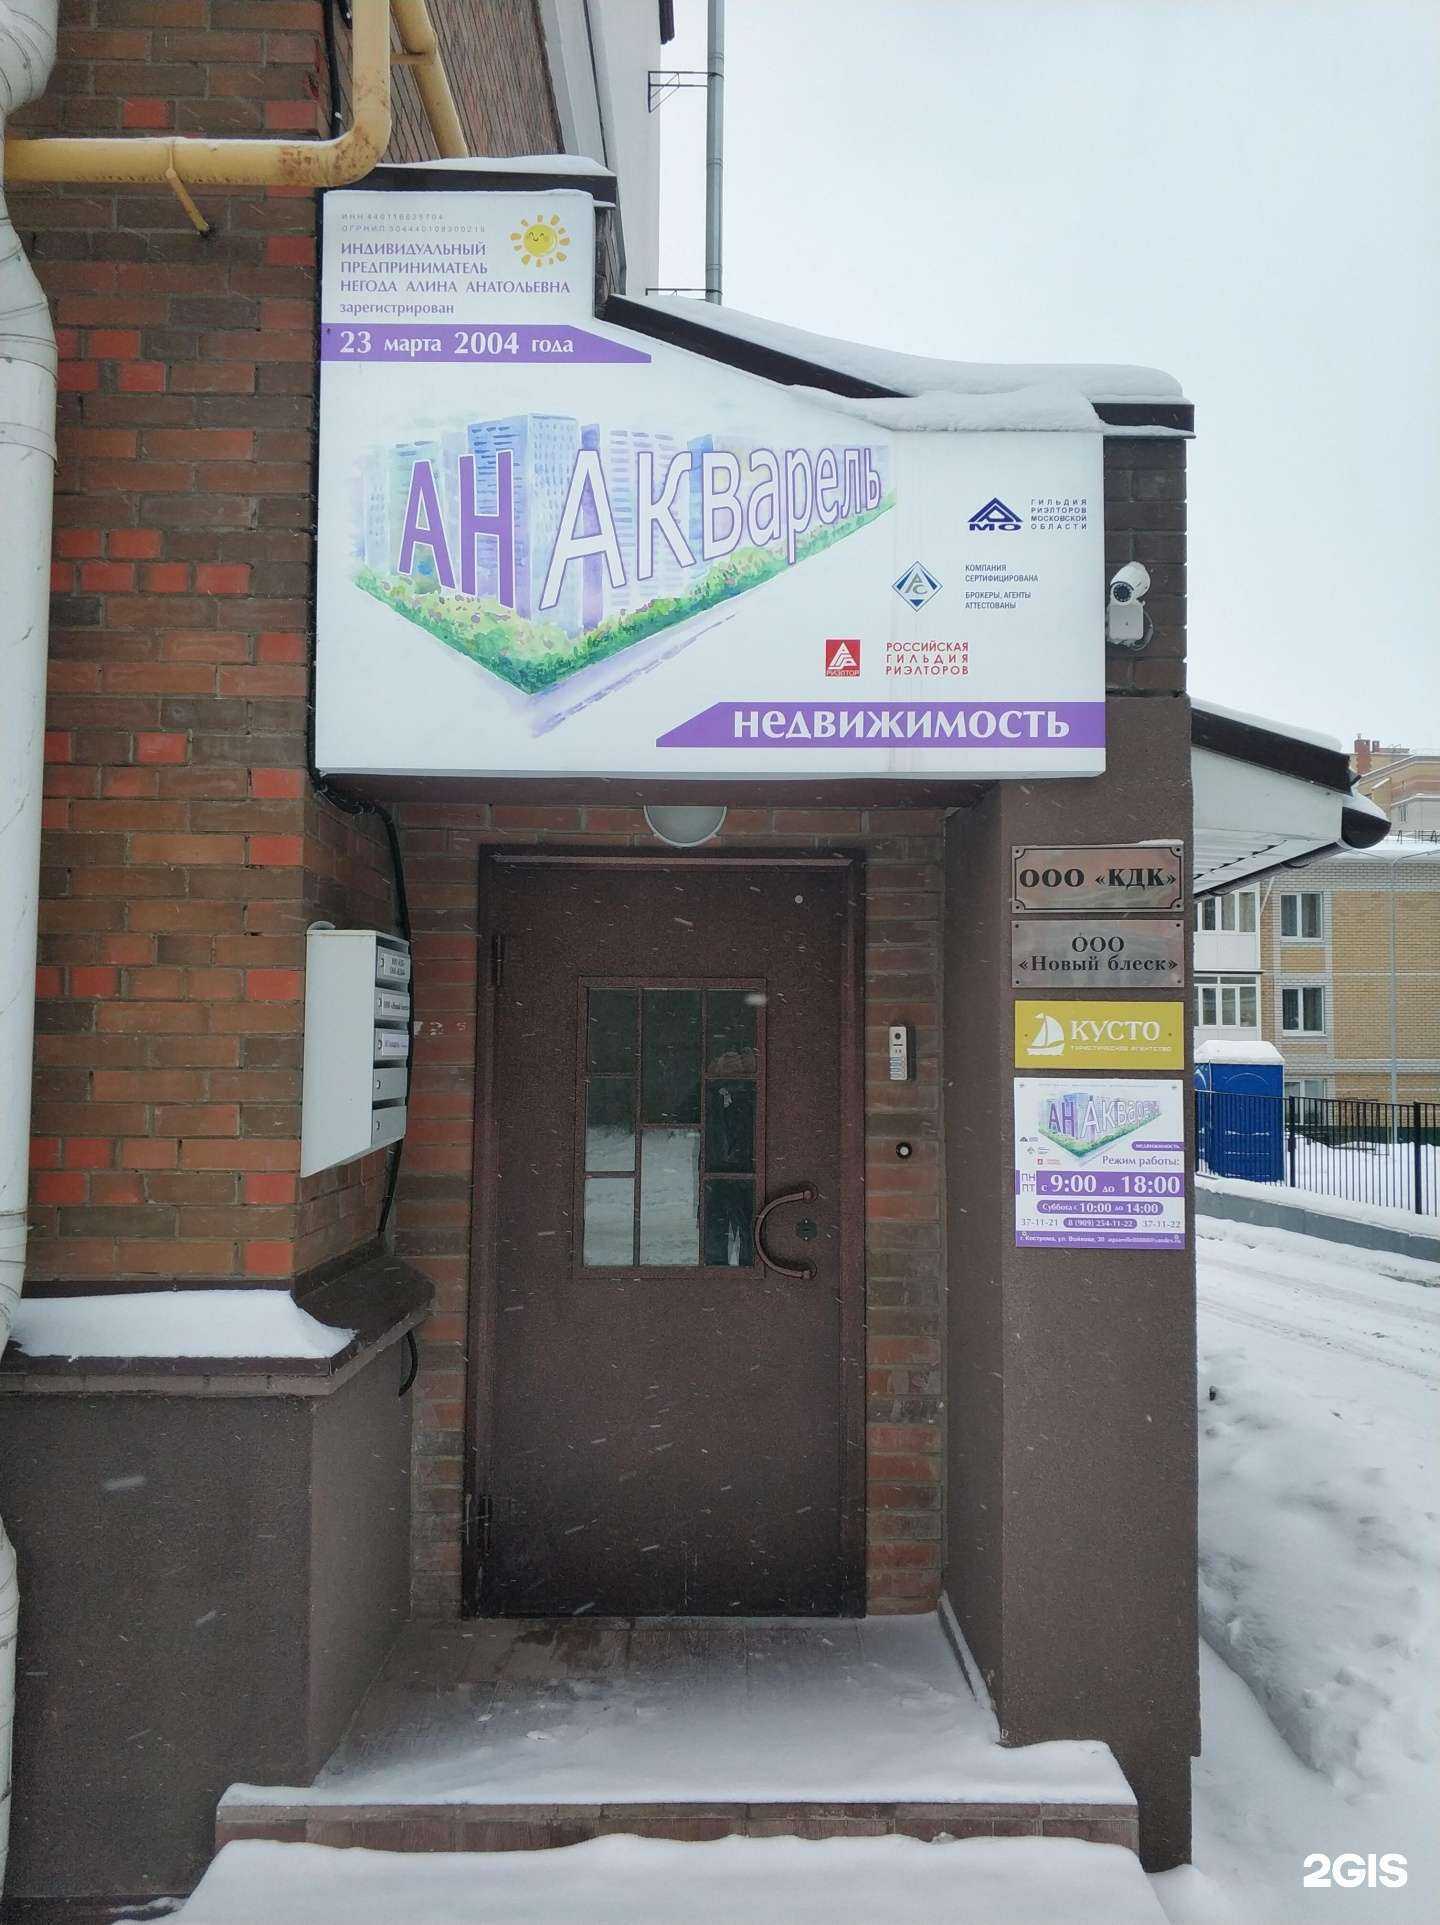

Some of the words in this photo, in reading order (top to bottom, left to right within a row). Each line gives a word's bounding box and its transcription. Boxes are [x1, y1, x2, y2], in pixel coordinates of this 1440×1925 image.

[340, 241, 486, 257] ИНДИВИДУАЛЬНЫЙ
[340, 261, 488, 275] ПРЕДПРИНИМАТЕЛЬ
[340, 281, 398, 293] НЕГОДА
[406, 281, 458, 293] АЛИНА
[465, 281, 570, 294] АНАТОЛЬЕВНА
[340, 304, 454, 317] зарегистрирован
[340, 331, 372, 353] 23
[384, 341, 442, 357] марта
[453, 332, 519, 355] 2004
[531, 340, 574, 353] года
[398, 449, 514, 610] АН
[965, 575, 1038, 583] СЕРТИФИЦИРОВАНА
[965, 592, 1002, 600] БРОКЕРЫ,
[886, 640, 968, 652] РОССИЙСКАЯ
[886, 654, 968, 664] ГИЛЬДИЯ
[886, 666, 968, 675] РИЭЛТОРОВ
[1020, 869, 1085, 887] ООО
[1095, 868, 1176, 889] «КДК»
[1072, 936, 1124, 952] ООО
[1018, 956, 1098, 971] «Новый
[1108, 955, 1178, 971] блеск»
[1071, 1020, 1160, 1041] КУСТО
[1049, 1101, 1075, 1137] АН
[1102, 1156, 1135, 1165] Режим
[1139, 1156, 1180, 1167] работы:
[1021, 1173, 1036, 1182] ПН
[1050, 1174, 1096, 1192] 9:00
[1121, 1175, 1180, 1193] 18:00
[1022, 1184, 1035, 1192] ПТ
[1079, 1203, 1112, 1213] 10:00
[1126, 1204, 1159, 1213] 14:00
